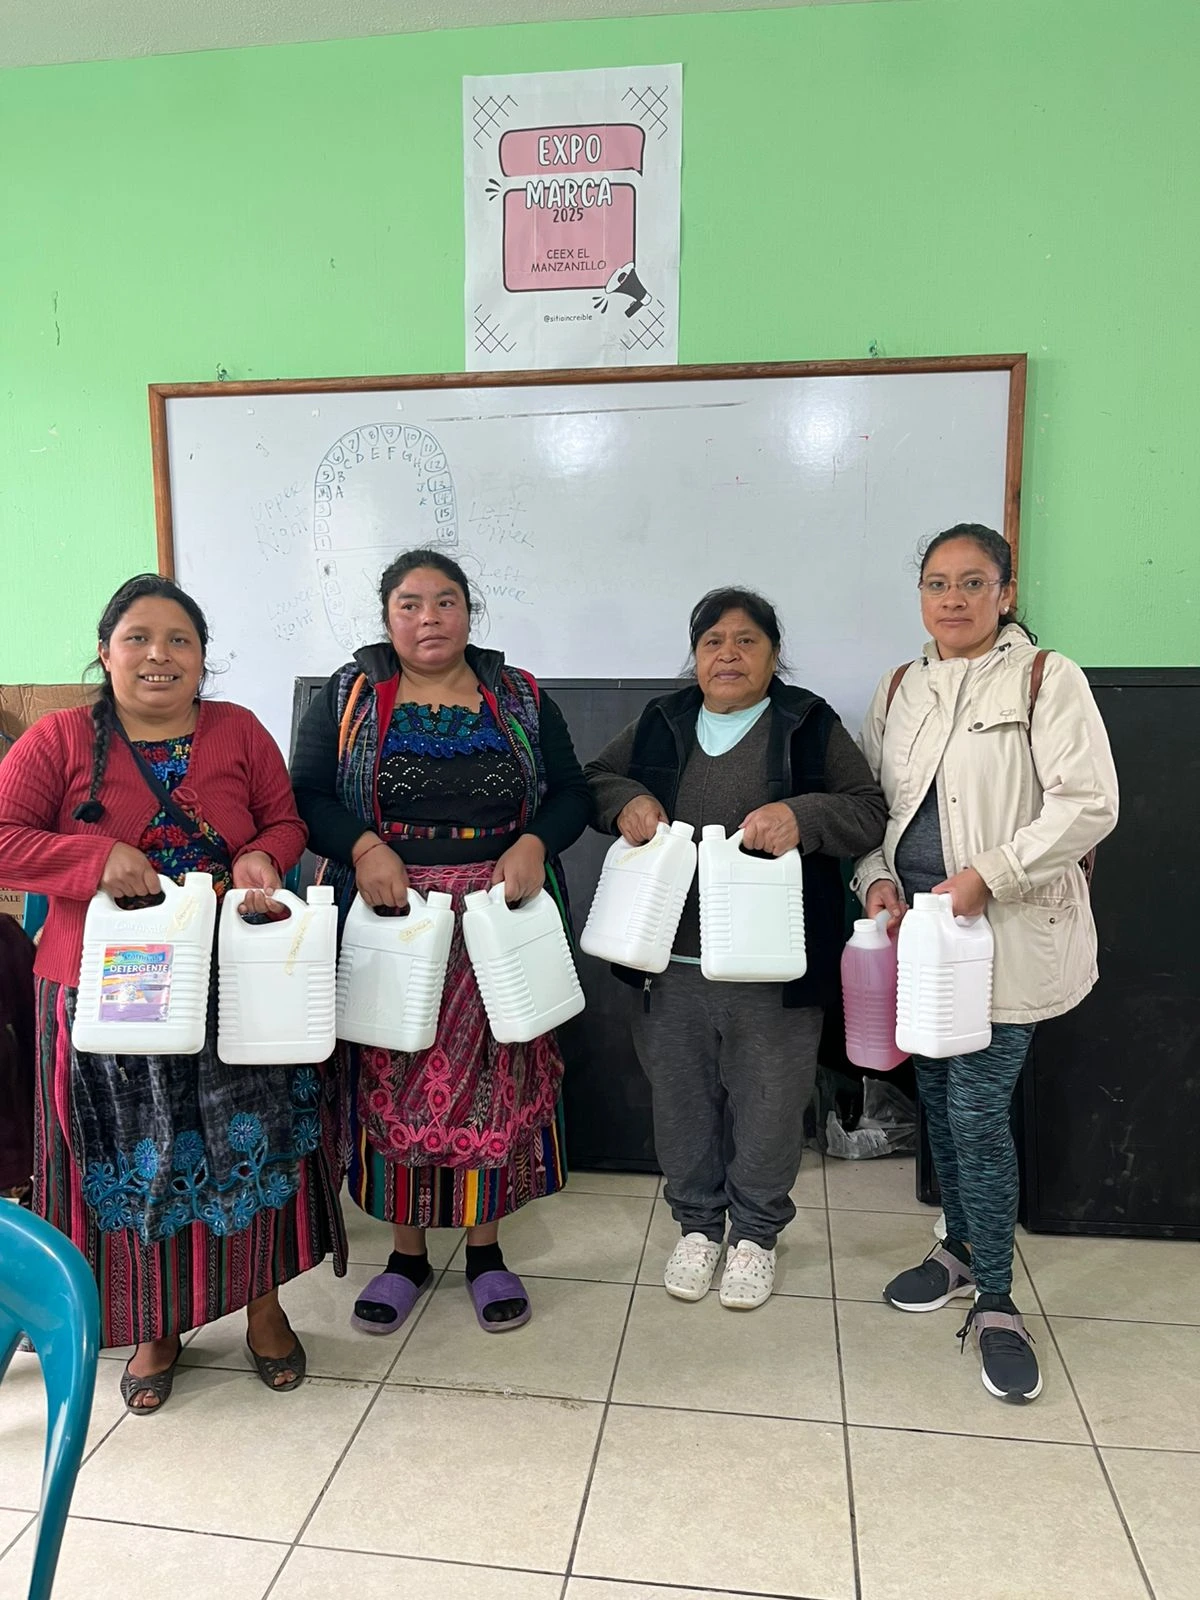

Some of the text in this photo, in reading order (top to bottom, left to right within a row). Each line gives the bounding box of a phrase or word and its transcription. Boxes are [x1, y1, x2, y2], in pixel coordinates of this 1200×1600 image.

[538, 133, 602, 166] EXPO
[525, 177, 613, 209] MARCA
[553, 207, 584, 223] 2025
[546, 248, 590, 260] CEEX EL
[531, 260, 607, 273] MANZANILLO
[543, 314, 593, 323] @sitioincreible
[368, 430, 376, 440] 8
[407, 432, 418, 442] 10
[347, 439, 355, 450] 7
[424, 444, 433, 453] 11
[356, 453, 365, 464] D
[371, 447, 381, 460] E
[387, 446, 397, 460] F
[401, 450, 413, 462] G
[429, 460, 442, 470] 12
[322, 470, 331, 481] 5
[337, 471, 346, 483] B
[336, 485, 344, 499] A
[440, 508, 451, 518] 15
[441, 527, 455, 538] 16
[110, 963, 169, 974] DETERGENTE
